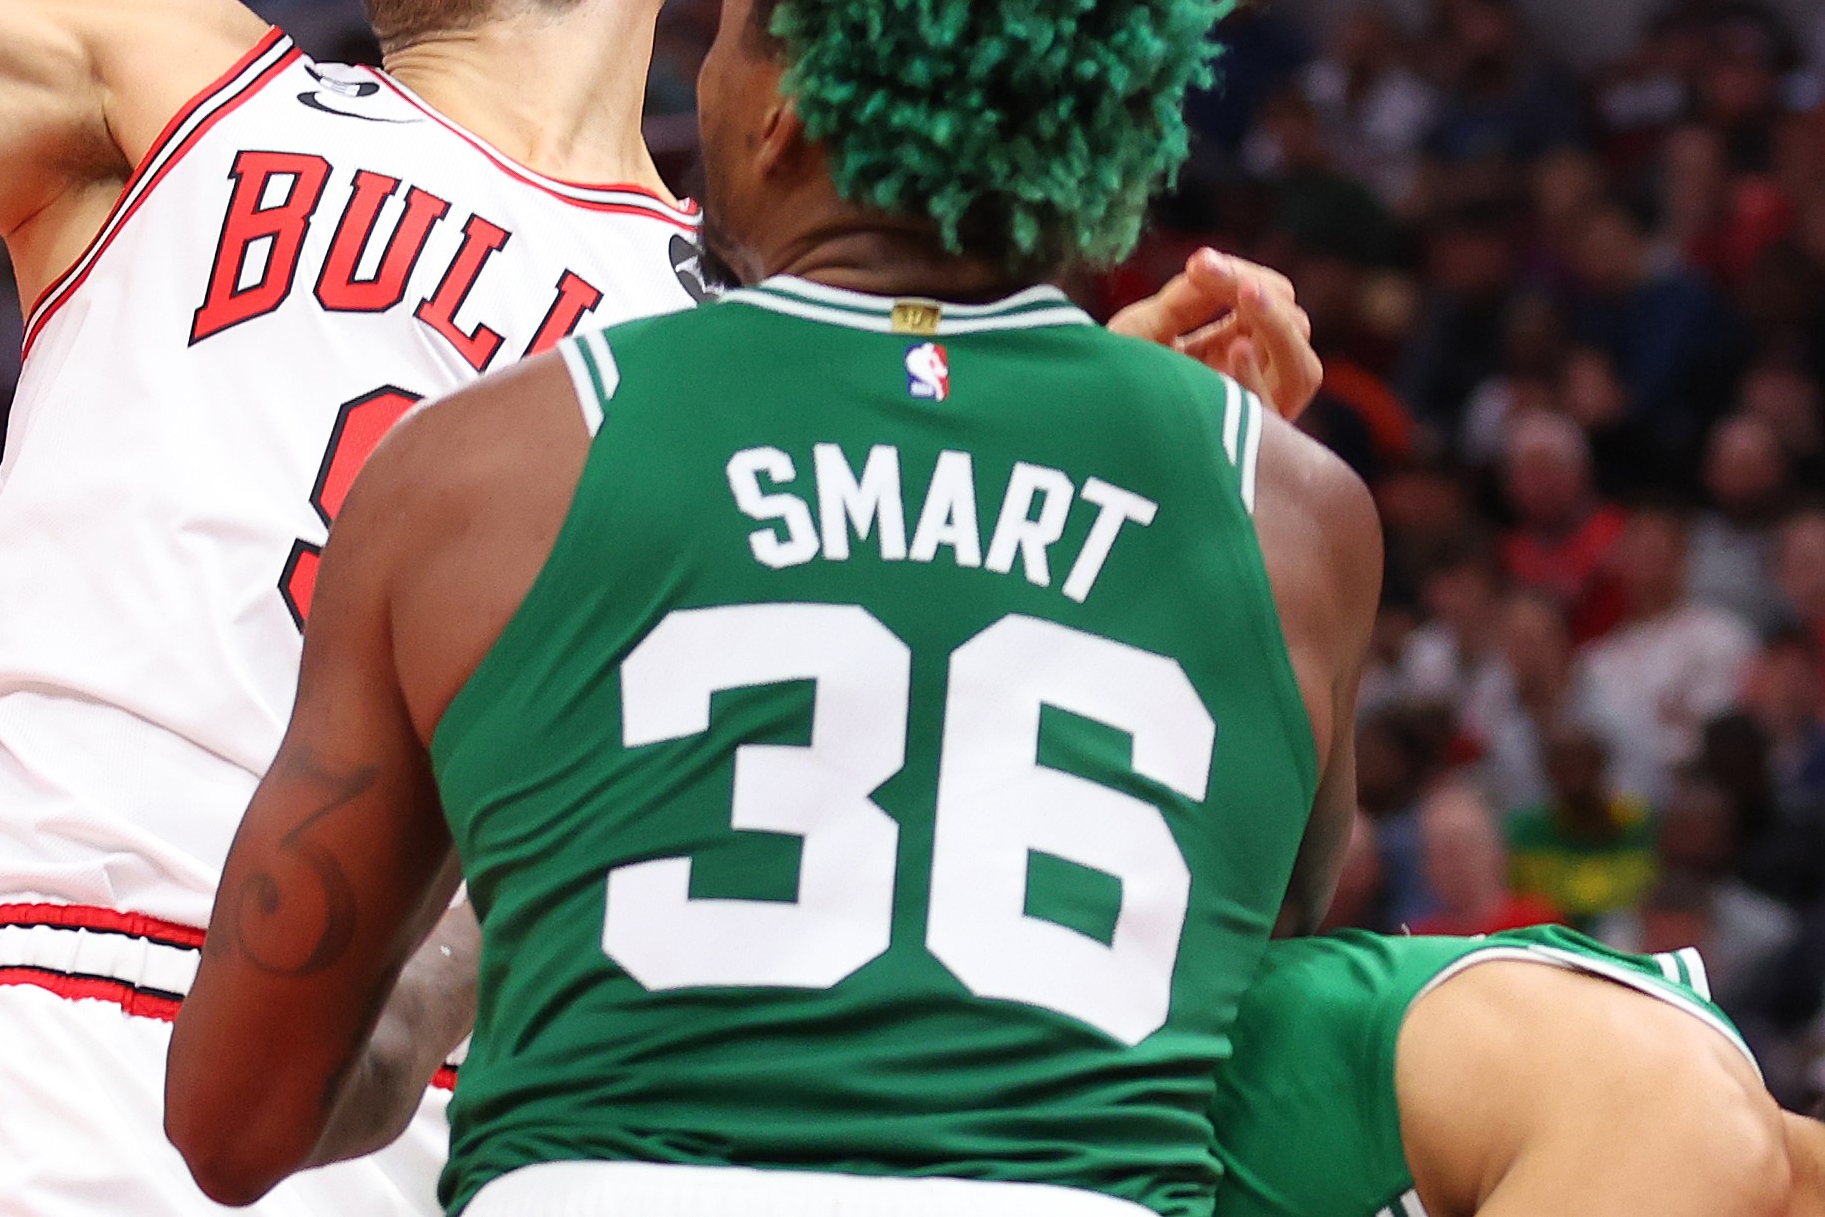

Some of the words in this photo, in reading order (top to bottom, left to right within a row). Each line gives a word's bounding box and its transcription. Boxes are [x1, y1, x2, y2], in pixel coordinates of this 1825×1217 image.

[188, 149, 600, 373] BUL
[726, 443, 1159, 603] SMART
[601, 601, 1217, 1046] 36
